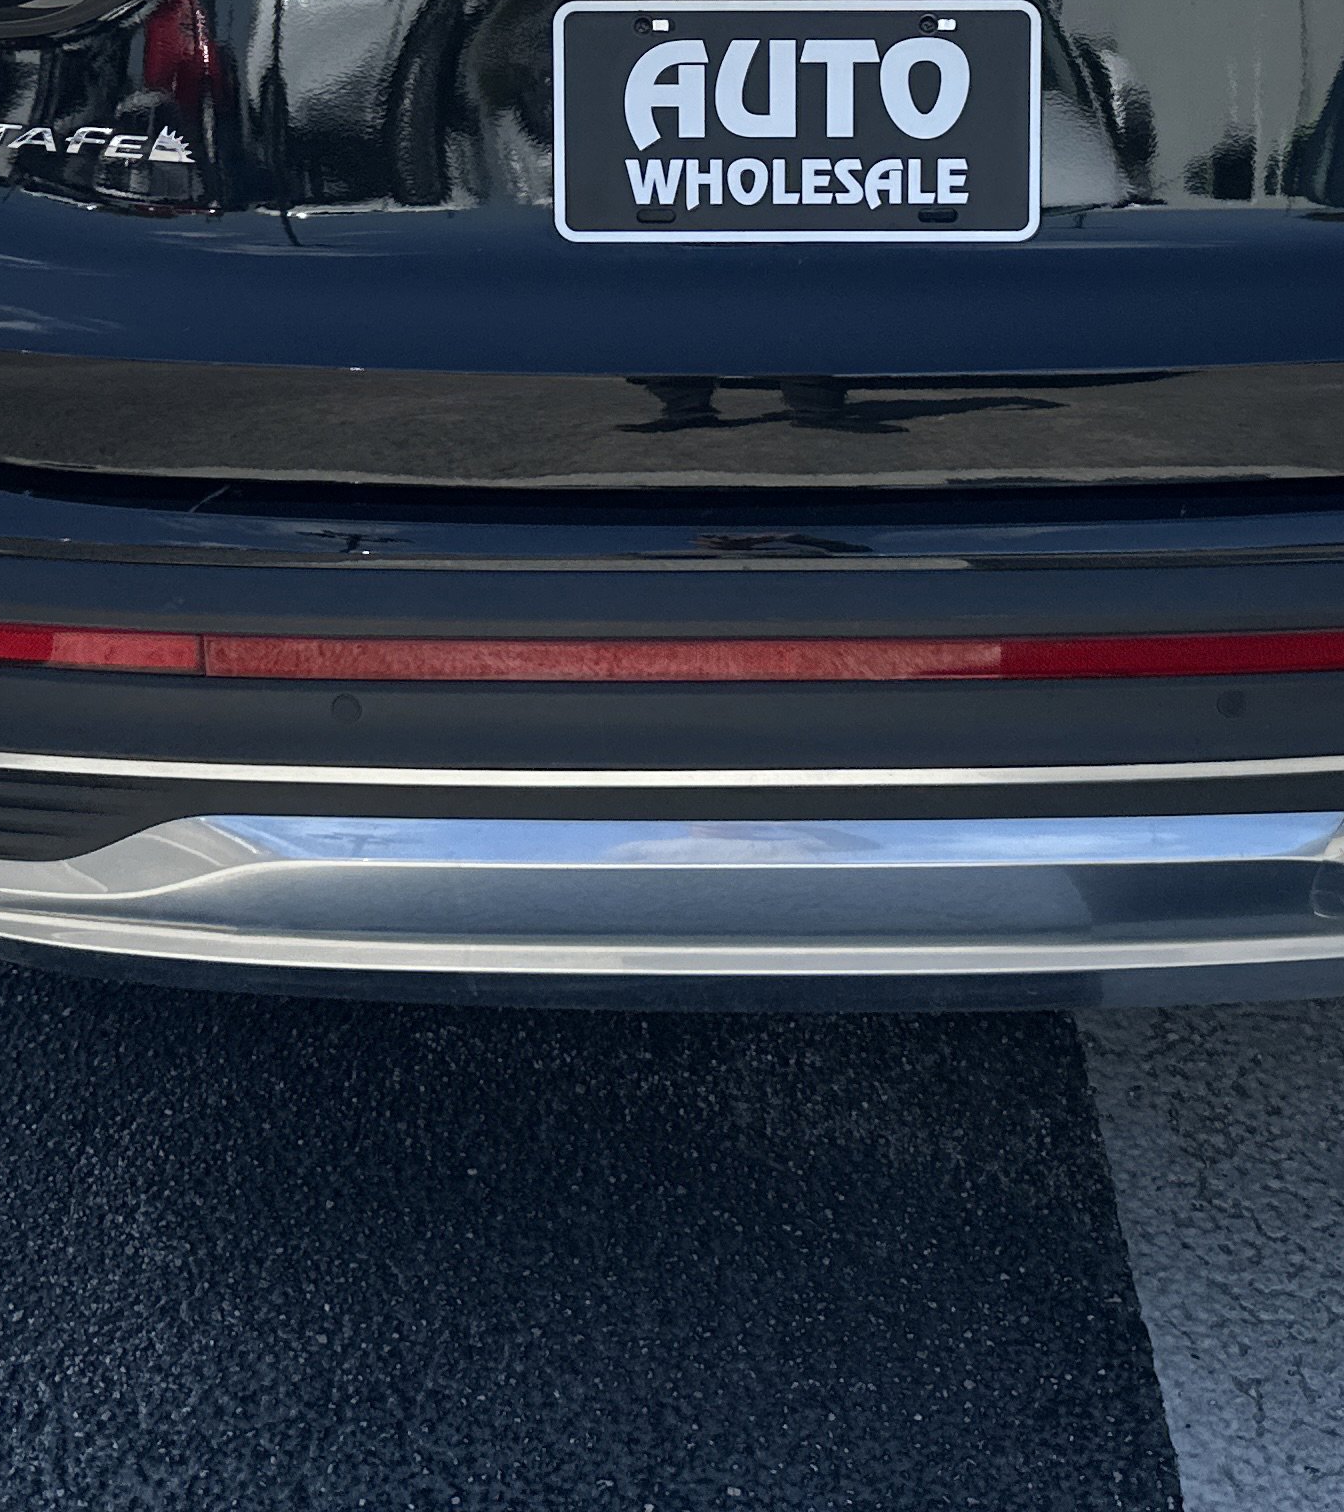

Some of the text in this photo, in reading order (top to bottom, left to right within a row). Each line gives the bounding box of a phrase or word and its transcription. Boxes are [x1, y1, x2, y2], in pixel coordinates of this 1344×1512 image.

[624, 36, 970, 152] AUTO
[65, 126, 148, 159] FE
[624, 157, 969, 211] WHOLESALE
